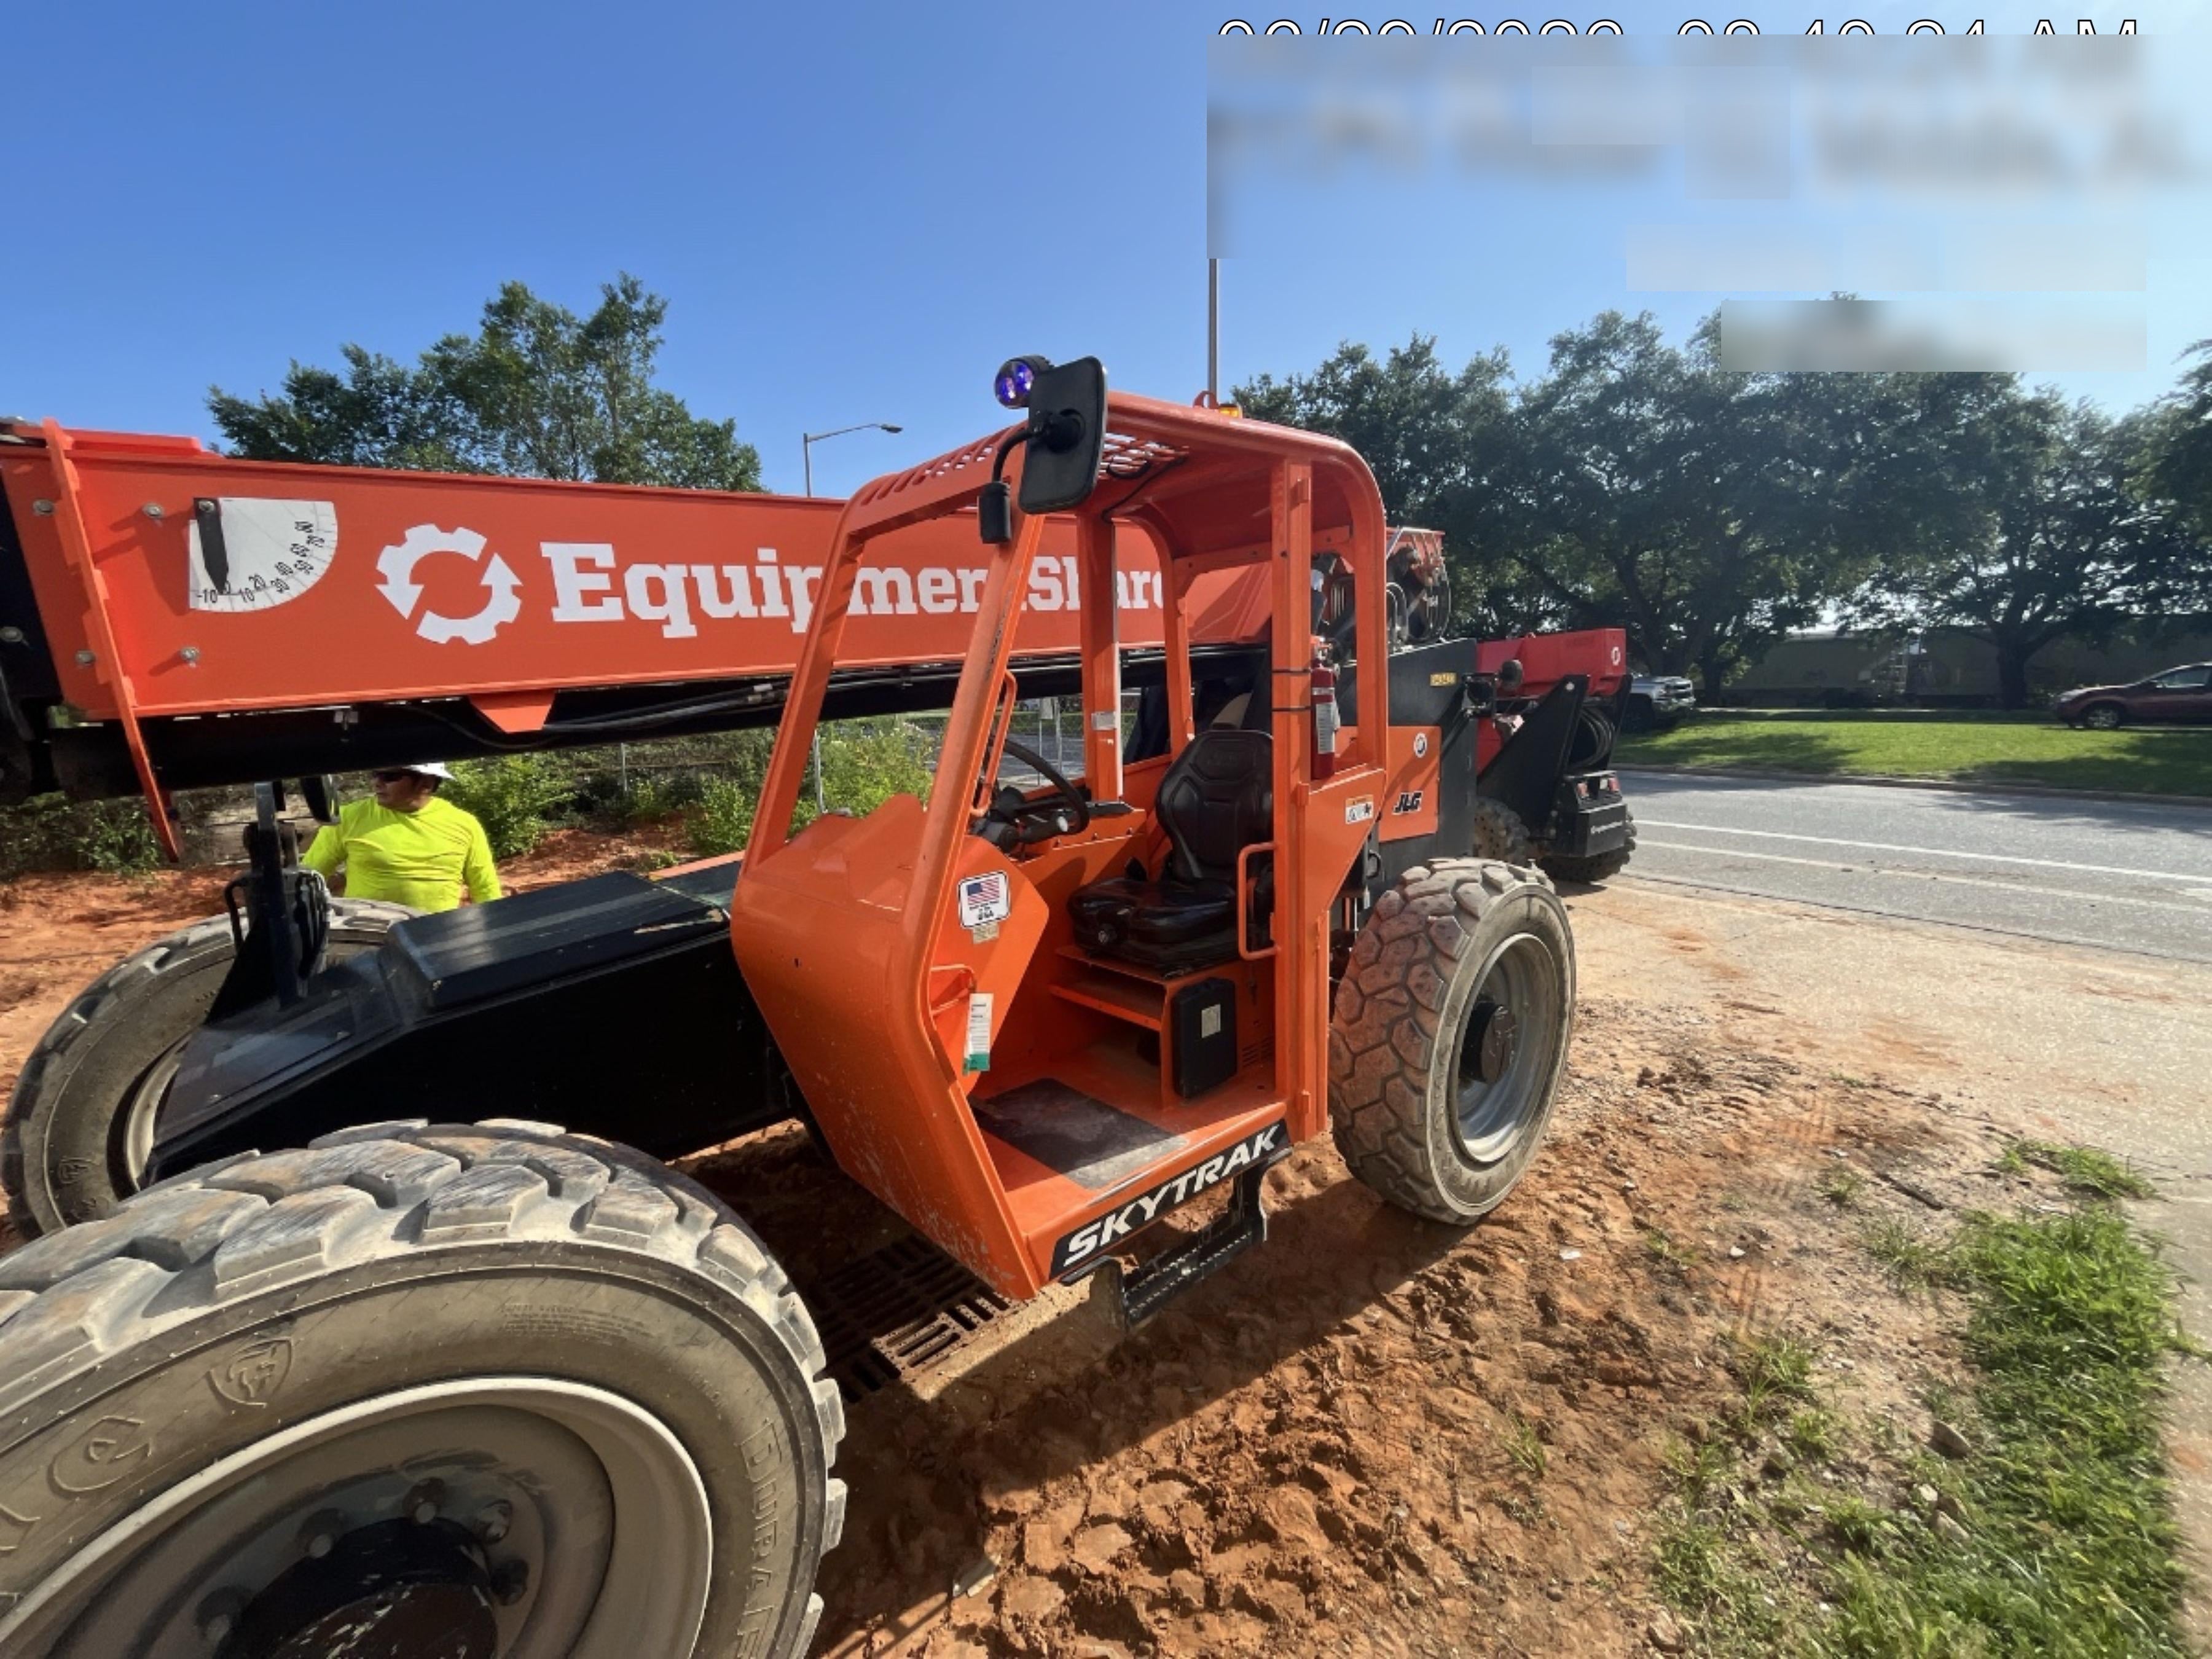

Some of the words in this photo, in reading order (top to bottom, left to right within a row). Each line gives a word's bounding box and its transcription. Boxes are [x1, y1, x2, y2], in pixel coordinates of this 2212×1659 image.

[197, 589, 218, 603] -10
[239, 588, 255, 603] 10
[248, 573, 266, 591] 20
[540, 541, 1164, 638] EquipmenSr
[1393, 791, 1422, 814] JLG
[1064, 1124, 1280, 1267] SKYTRAK
